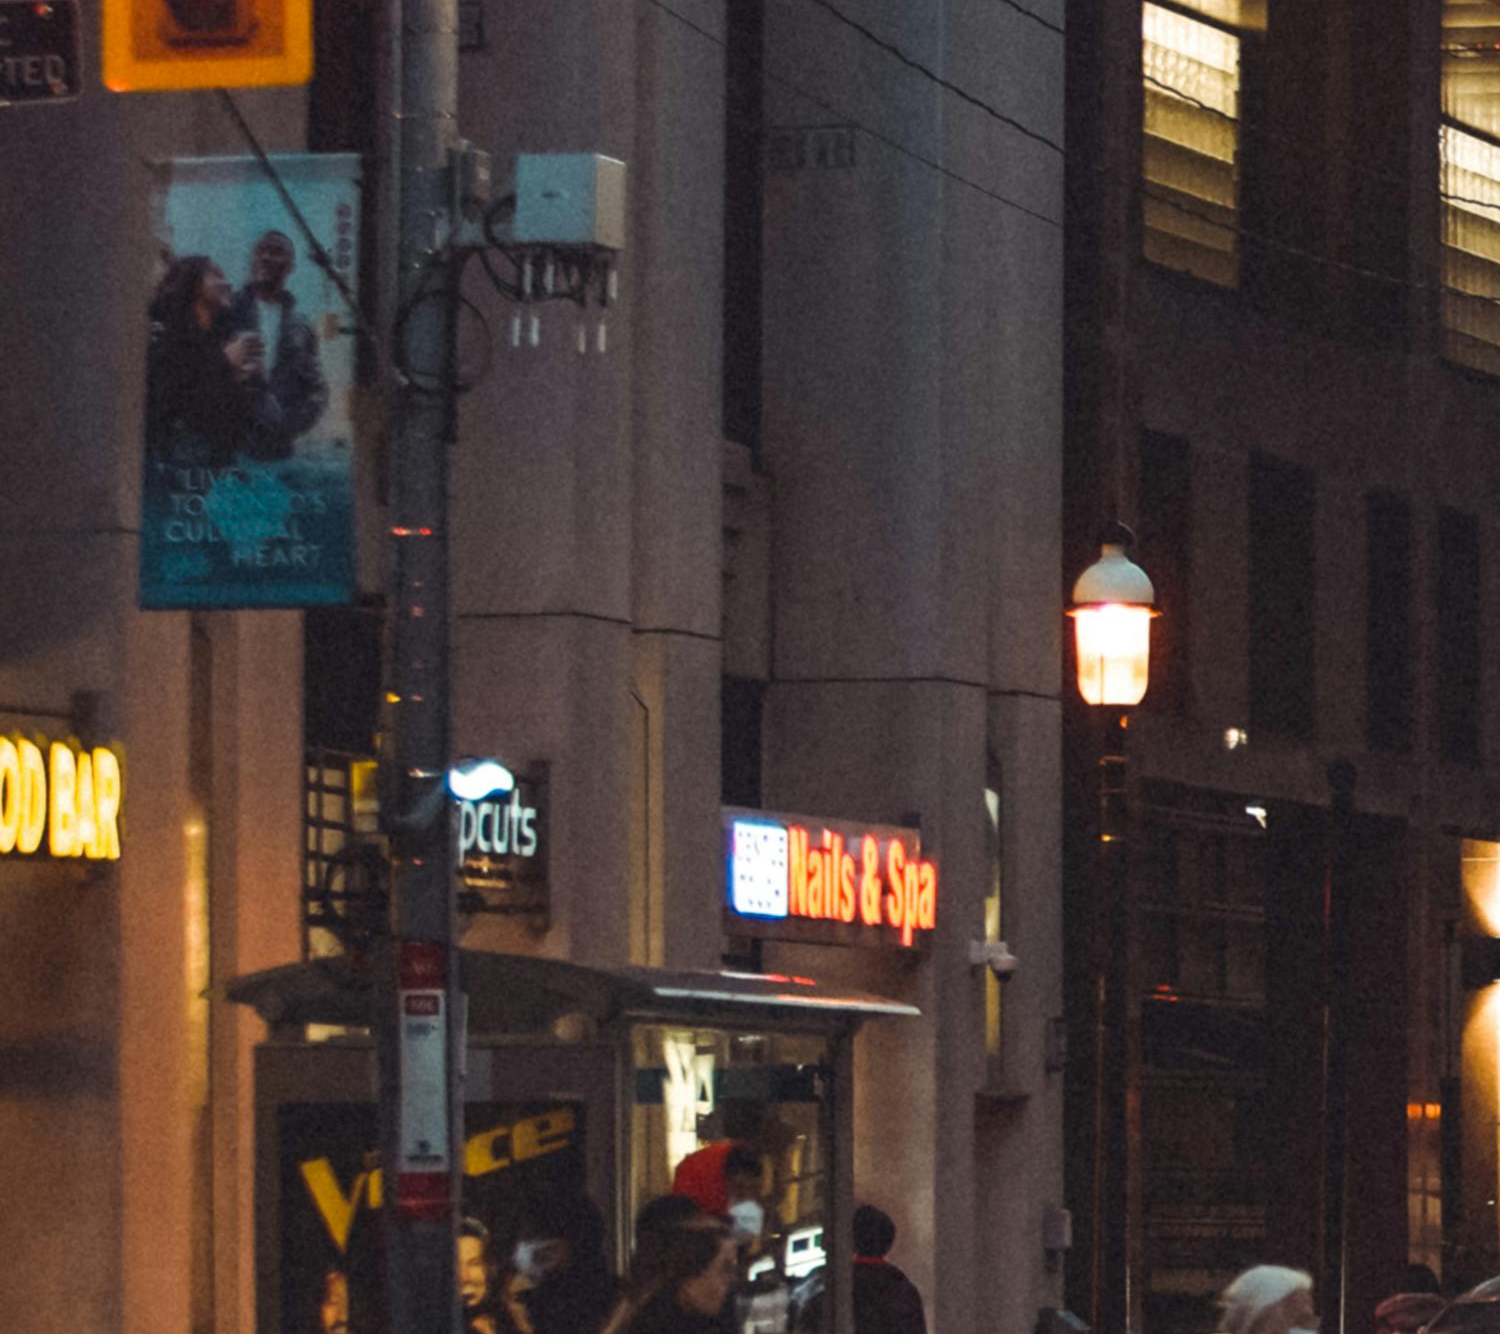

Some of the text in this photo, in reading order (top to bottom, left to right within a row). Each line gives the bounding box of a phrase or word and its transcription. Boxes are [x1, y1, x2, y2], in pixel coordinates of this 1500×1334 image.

[165, 520, 303, 544] CULAL
[49, 741, 121, 860] BAR
[788, 825, 856, 923] Nails
[860, 833, 882, 926] &
[886, 838, 937, 948] Spa
[301, 1107, 575, 1255] Vce
